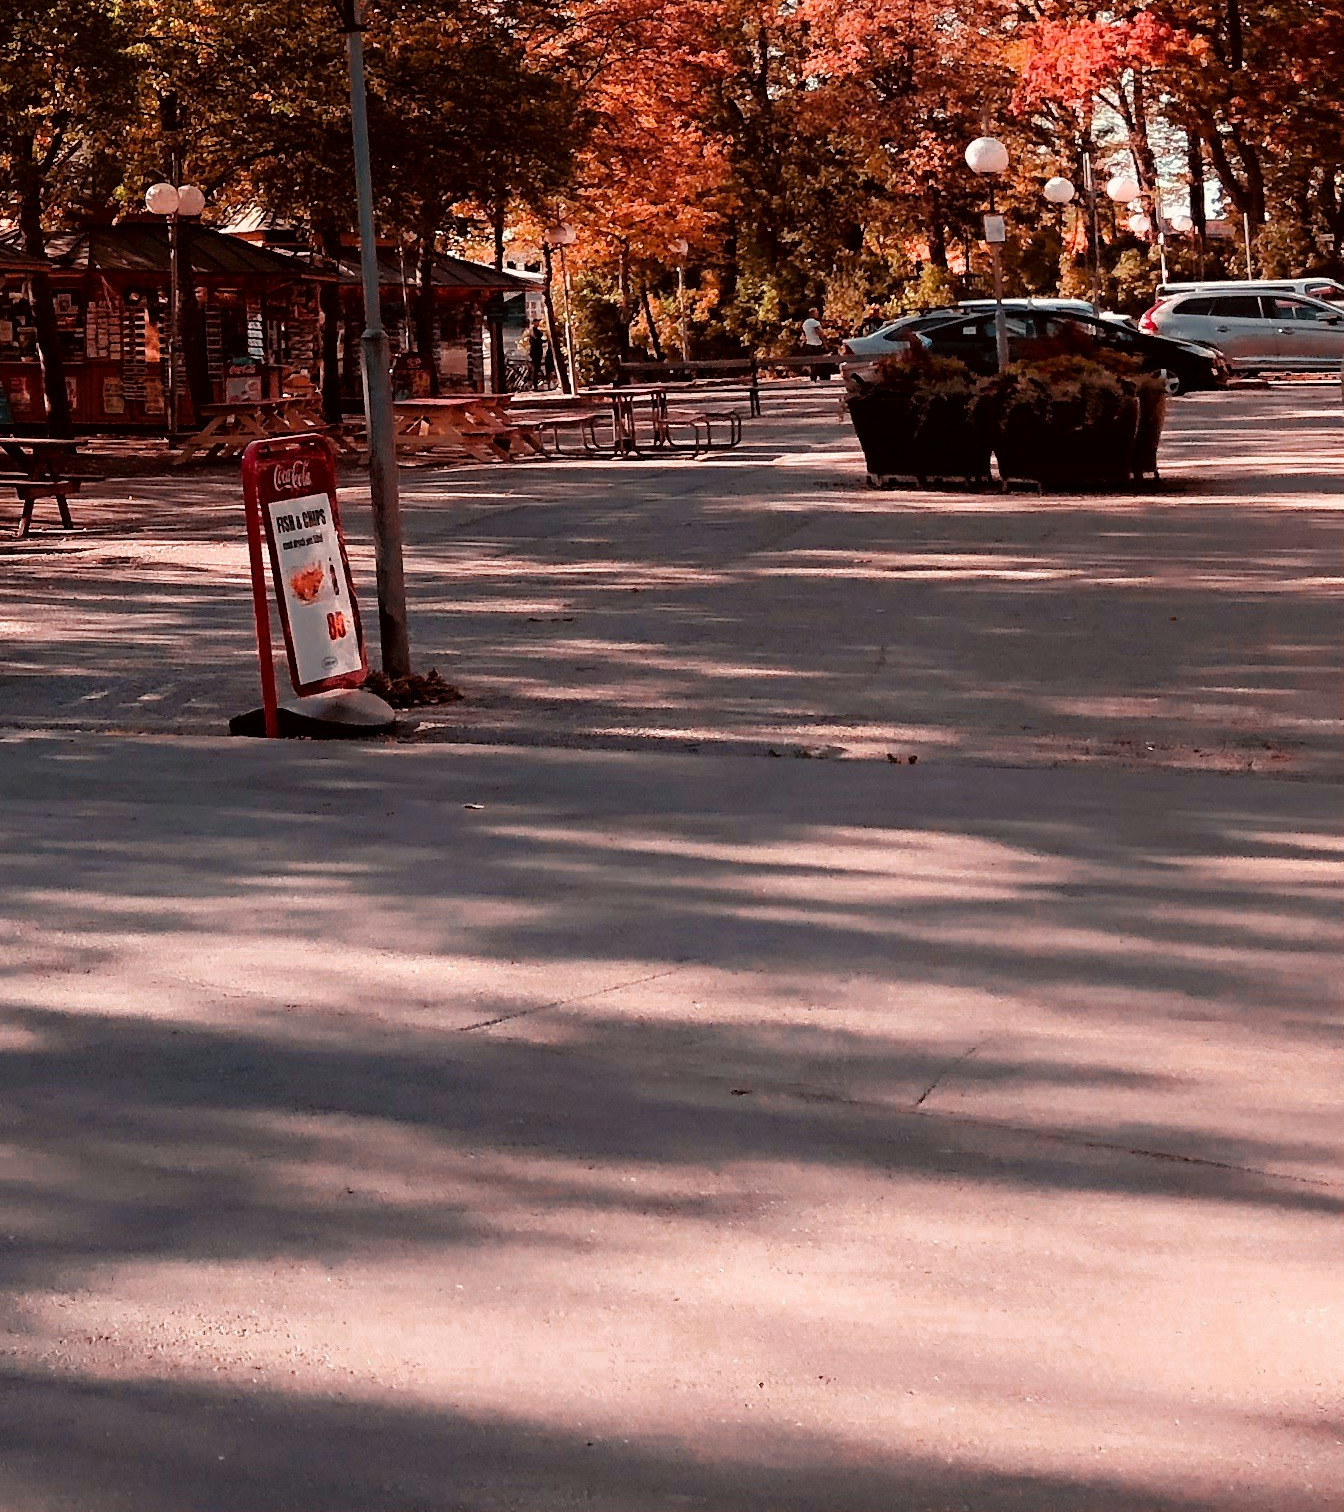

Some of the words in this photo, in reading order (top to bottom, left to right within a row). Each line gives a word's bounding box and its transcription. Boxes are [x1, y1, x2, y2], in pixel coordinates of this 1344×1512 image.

[273, 459, 313, 492] Coca-Cola
[276, 514, 296, 534] FISH
[296, 515, 303, 530] &
[302, 508, 327, 529] CHIPS
